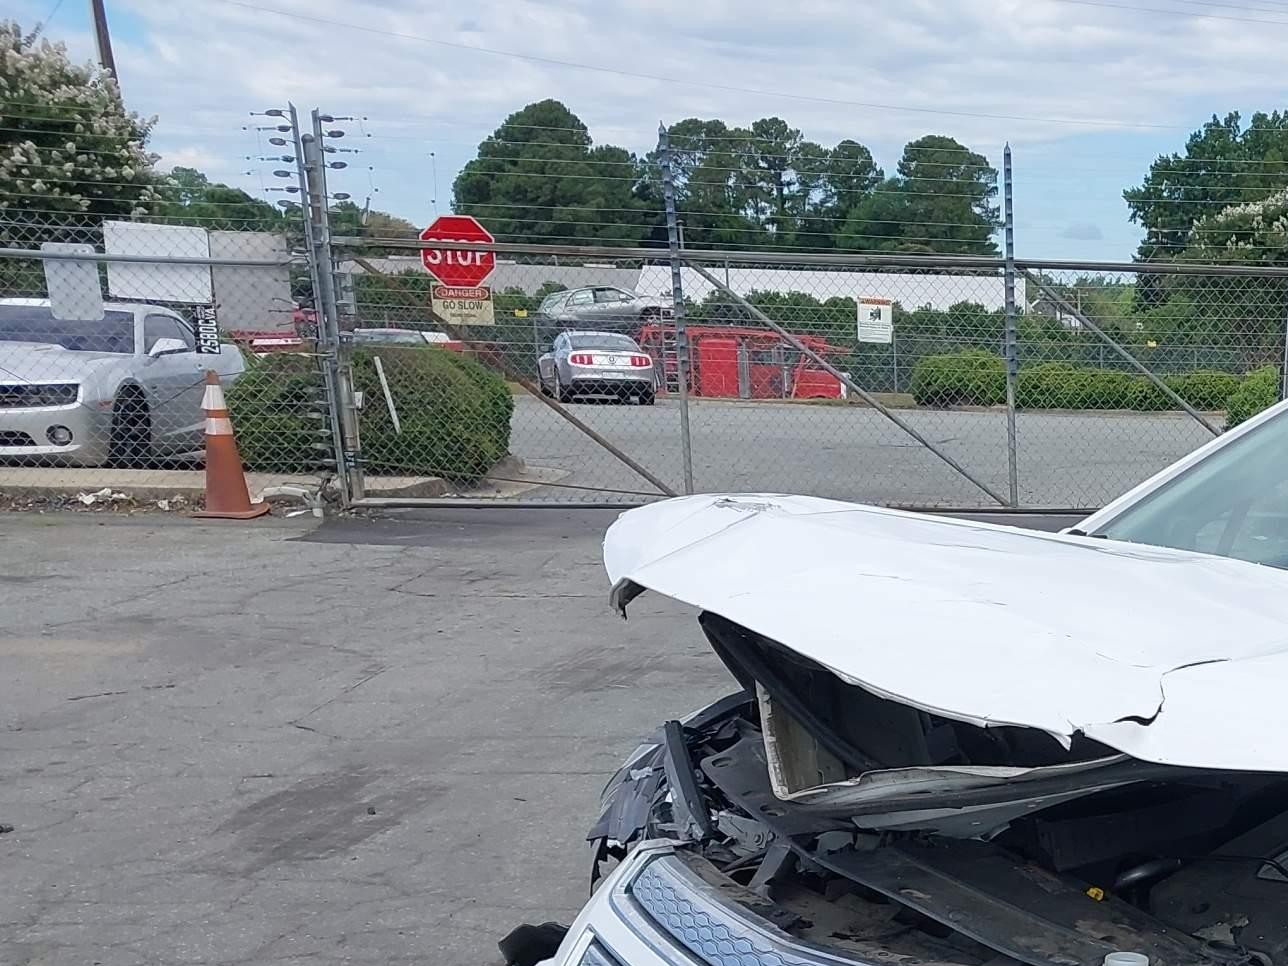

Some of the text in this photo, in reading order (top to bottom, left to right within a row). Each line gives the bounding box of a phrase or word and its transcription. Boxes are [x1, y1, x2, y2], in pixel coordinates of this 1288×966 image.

[427, 238, 489, 266] STOP
[441, 288, 482, 298] DANGER
[443, 301, 483, 311] GO SLOW
